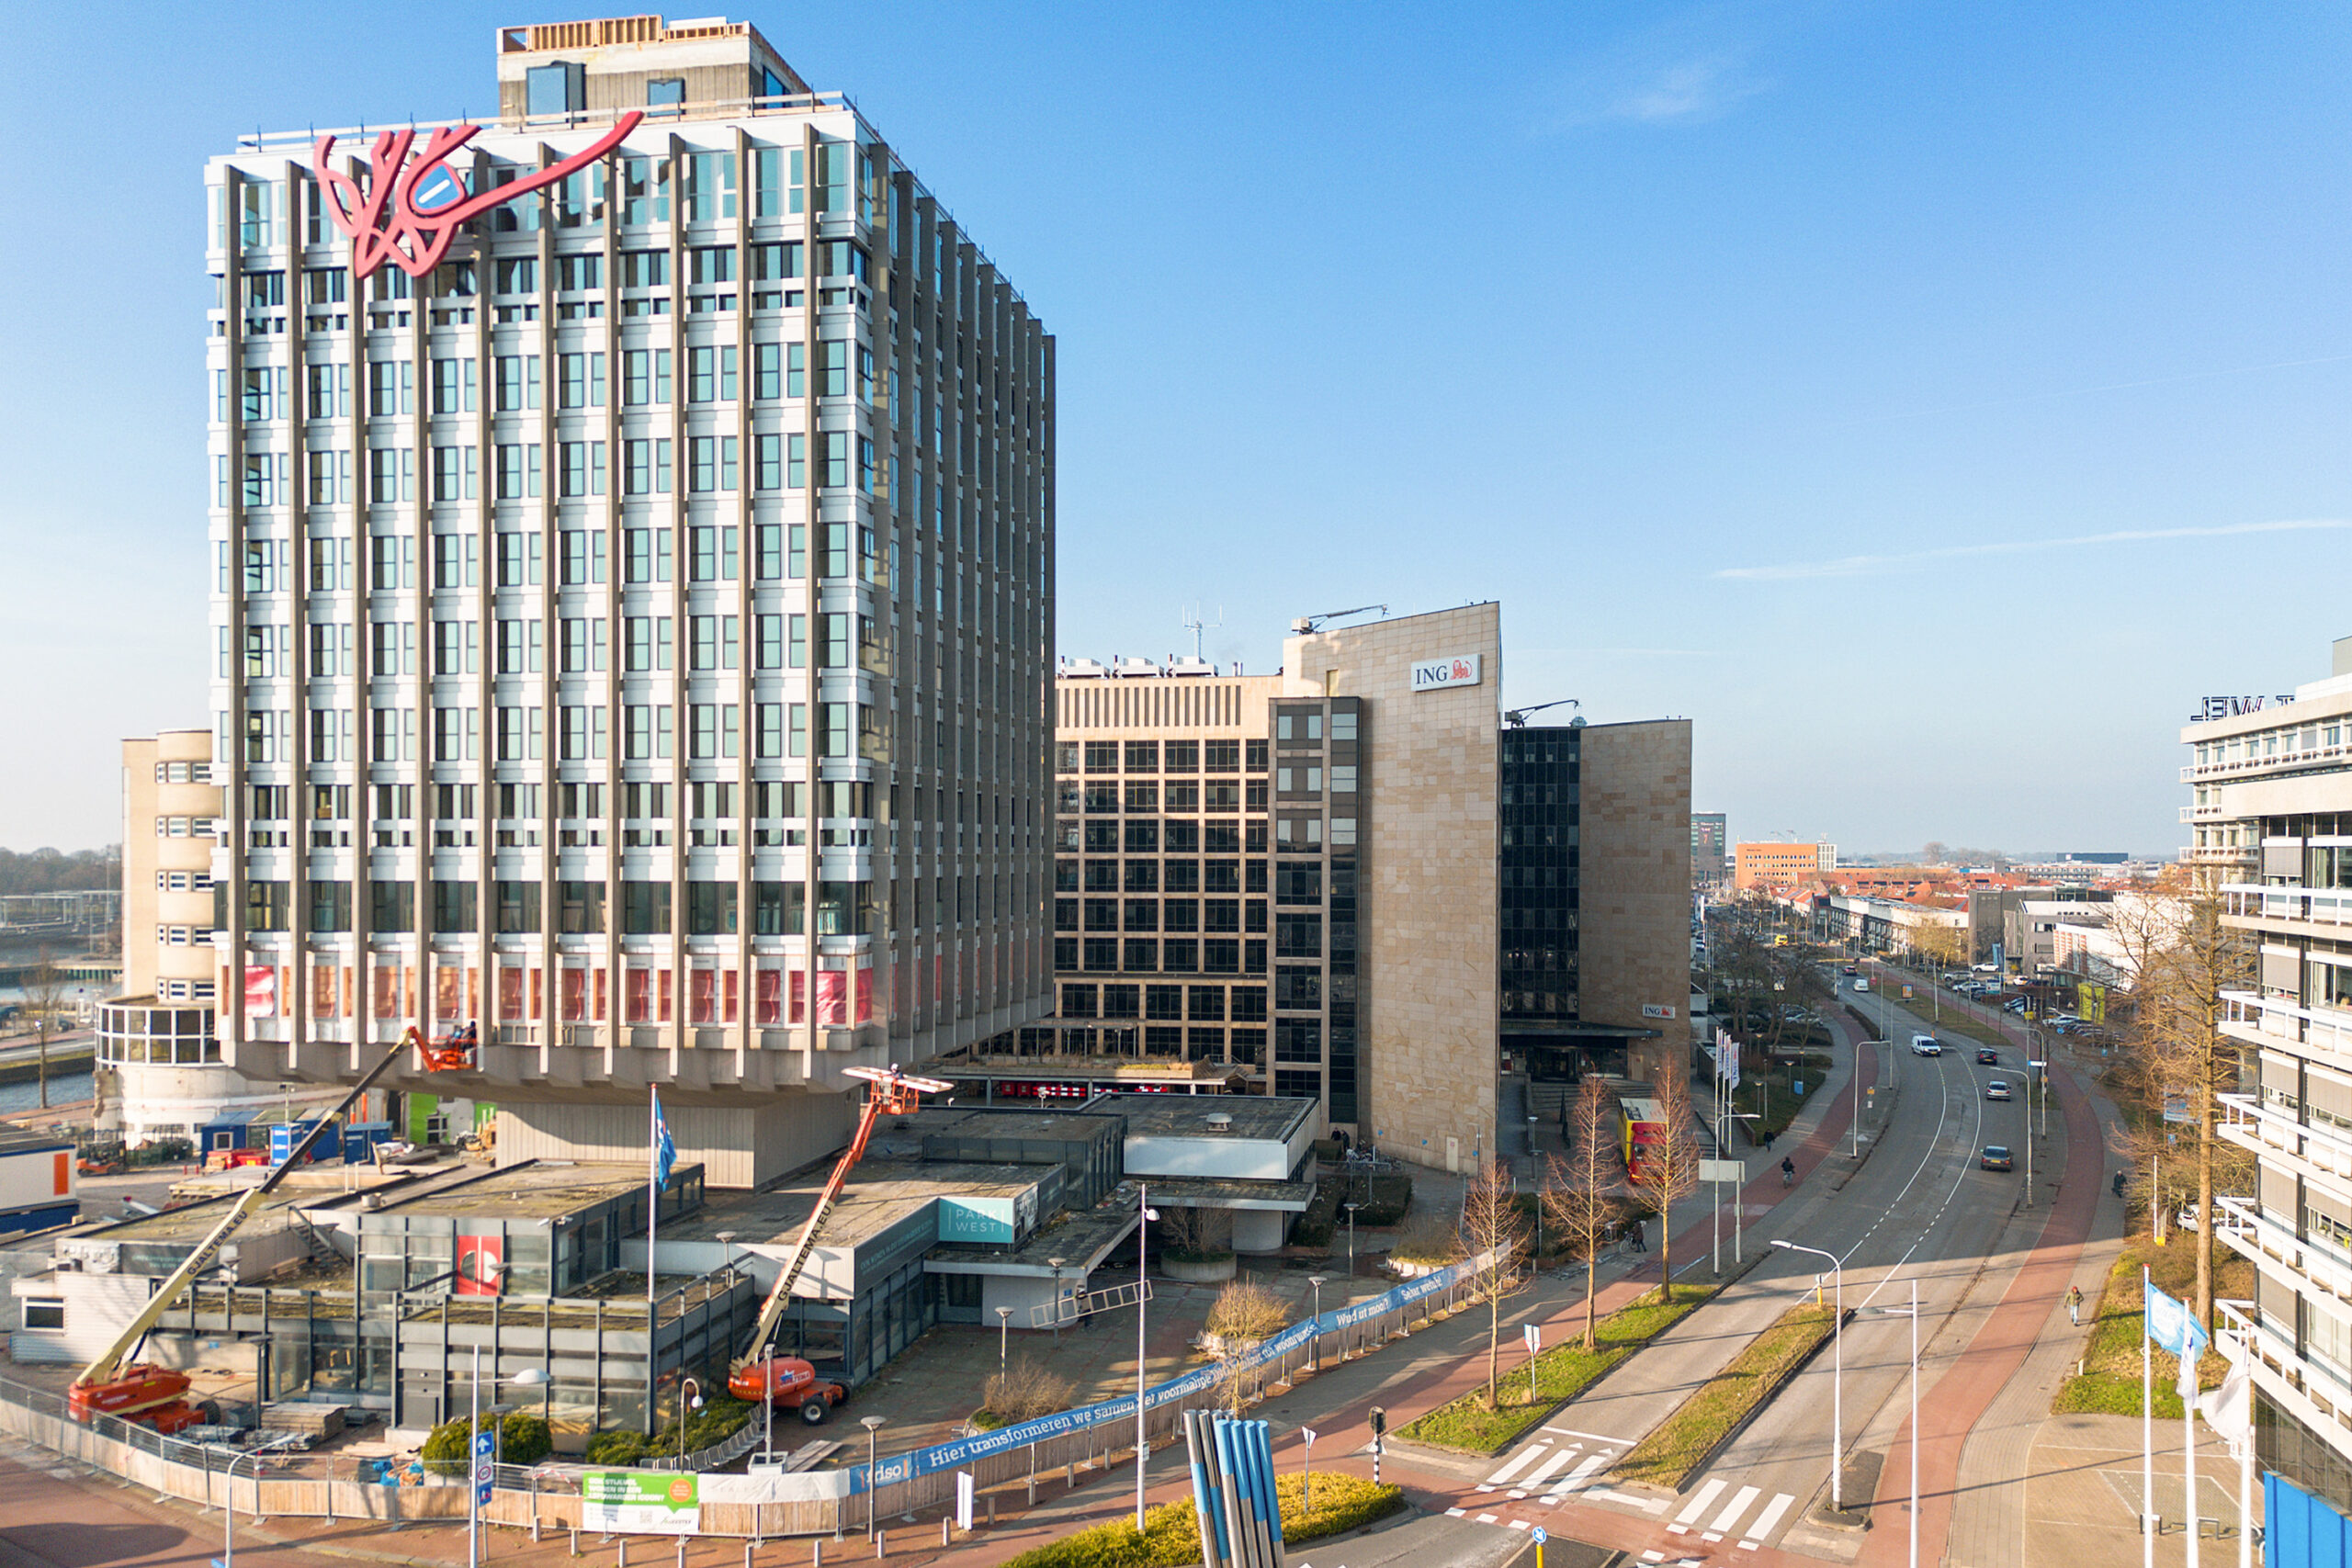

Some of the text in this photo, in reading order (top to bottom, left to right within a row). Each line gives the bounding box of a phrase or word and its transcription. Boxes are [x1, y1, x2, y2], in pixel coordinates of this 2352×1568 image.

[1416, 665, 1449, 685] ING
[1645, 1006, 1660, 1016] ING
[956, 1209, 999, 1220] PARK
[956, 1222, 997, 1233] WEST
[187, 1210, 248, 1275] GJALTEMA.EU
[777, 1204, 832, 1302] GJALTEMA.EU
[929, 1444, 967, 1468] Hier
[967, 1415, 1072, 1455] transformeren
[1074, 1408, 1091, 1424] we
[1093, 1400, 1136, 1419] samen
[1158, 1372, 1213, 1404] voormalige
